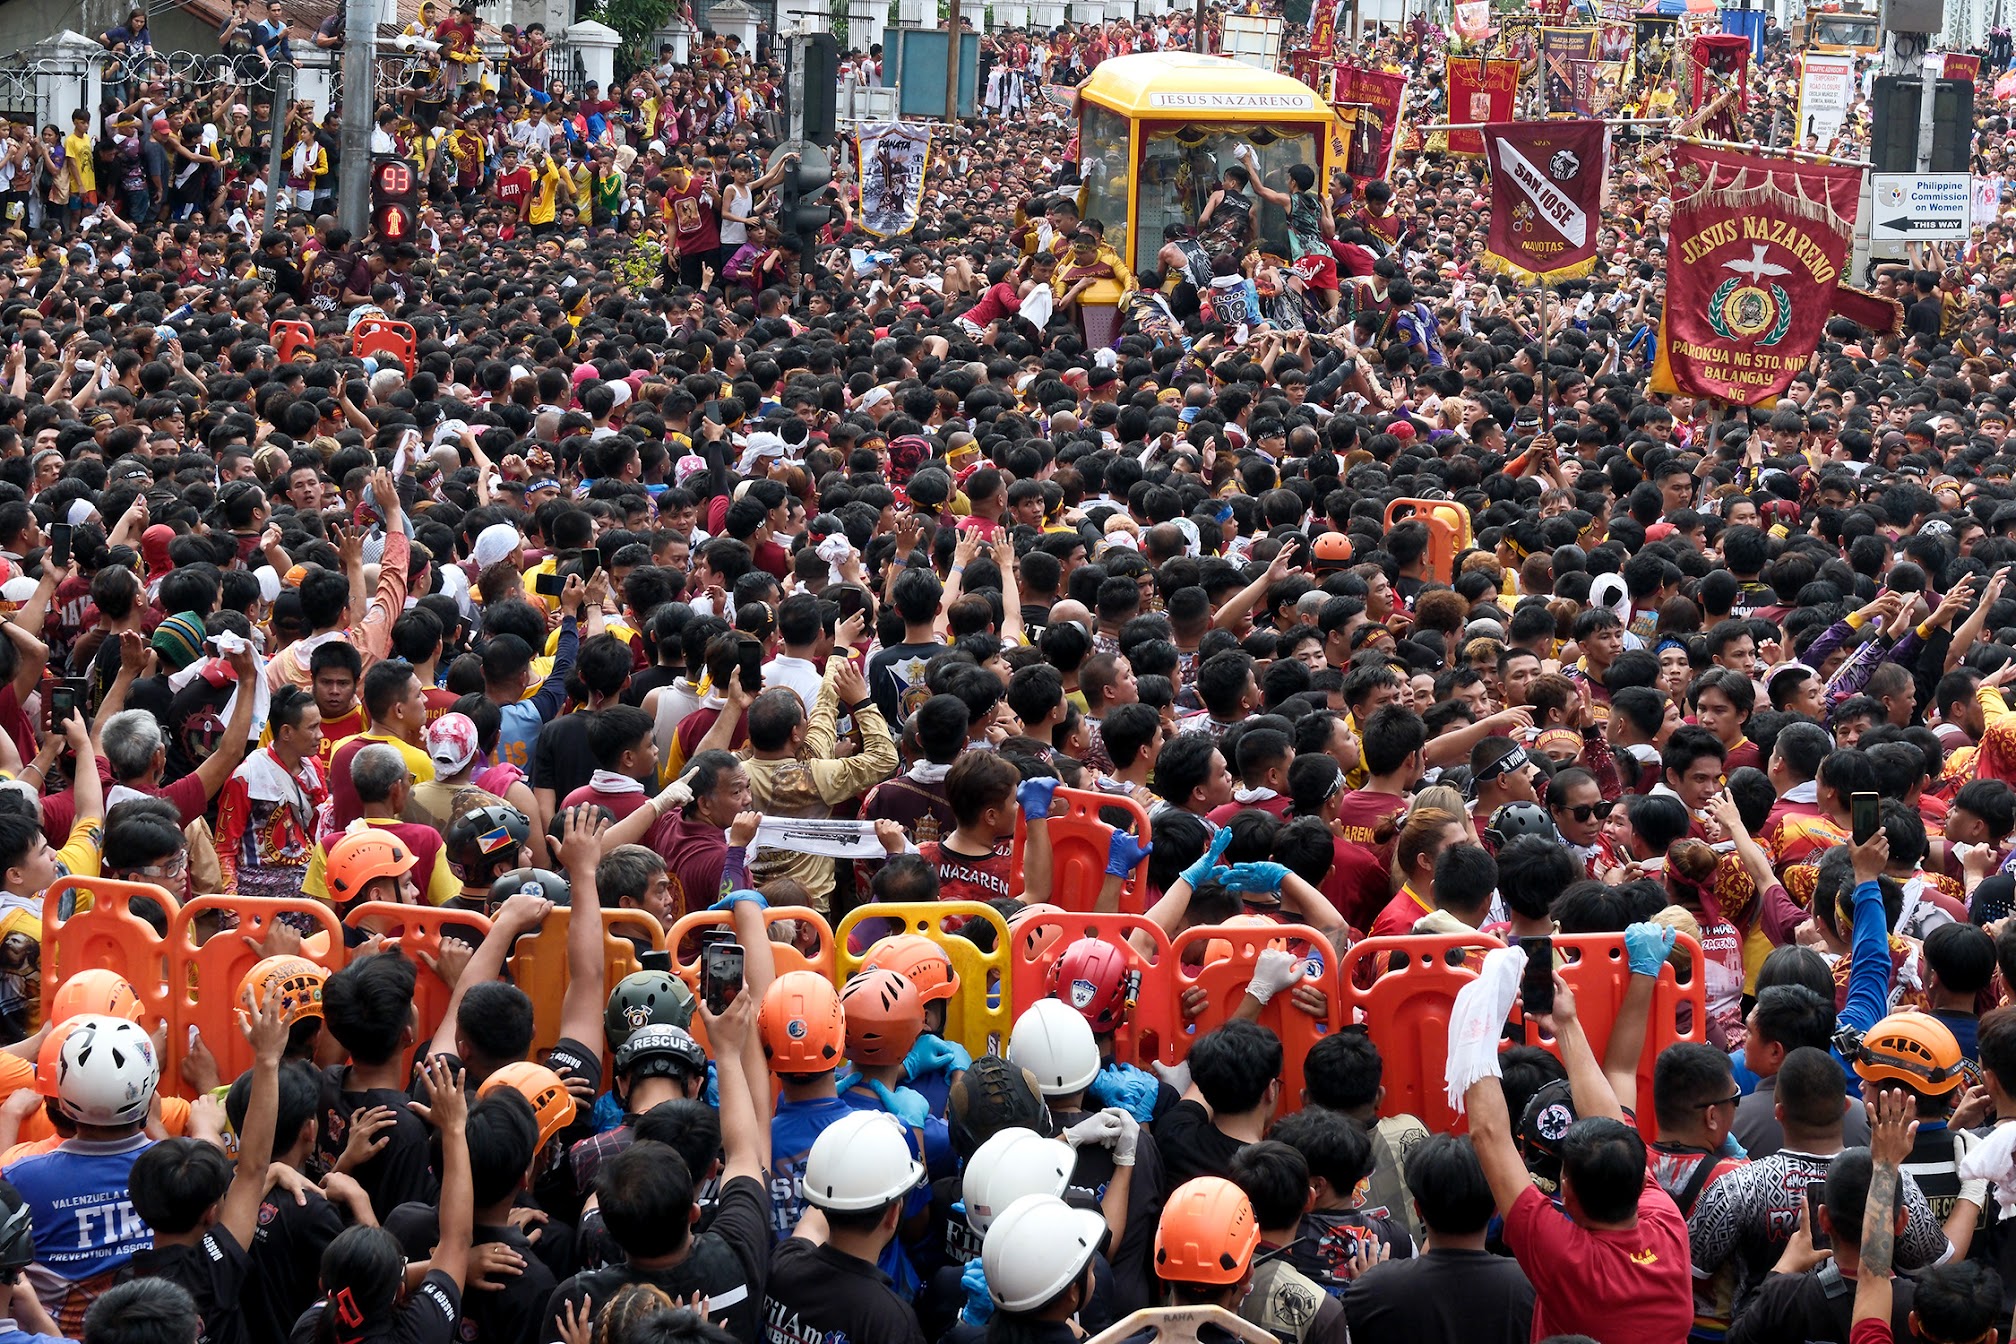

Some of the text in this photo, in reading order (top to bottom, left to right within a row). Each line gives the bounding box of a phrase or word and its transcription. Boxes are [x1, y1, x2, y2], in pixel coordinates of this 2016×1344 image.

[1809, 65, 1825, 73] TRAFFIC
[1160, 94, 1303, 107] JESUS NAZARENO
[383, 167, 409, 191] 93
[1917, 181, 1963, 191] Philippine
[501, 183, 520, 197] DELTA
[1513, 162, 1576, 228] SAN JOSE
[1911, 192, 1968, 200] Commission
[1929, 203, 1964, 211] Women
[1521, 240, 1565, 252] NAVOTAS
[1680, 215, 1836, 284] JESUS NAZARENO
[1216, 299, 1247, 325] 08
[1672, 340, 1730, 364] PAROKYA
[1733, 352, 1752, 367] NG
[1754, 354, 1782, 369] STO.
[1704, 365, 1774, 385] BALANGAY
[1728, 387, 1746, 401] NG
[1341, 825, 1376, 844] AREN
[633, 1035, 689, 1052] RESCUE
[51, 1190, 120, 1209] VALENZUELA
[75, 1200, 154, 1249] FIR
[48, 1247, 113, 1262] PREVENTION
